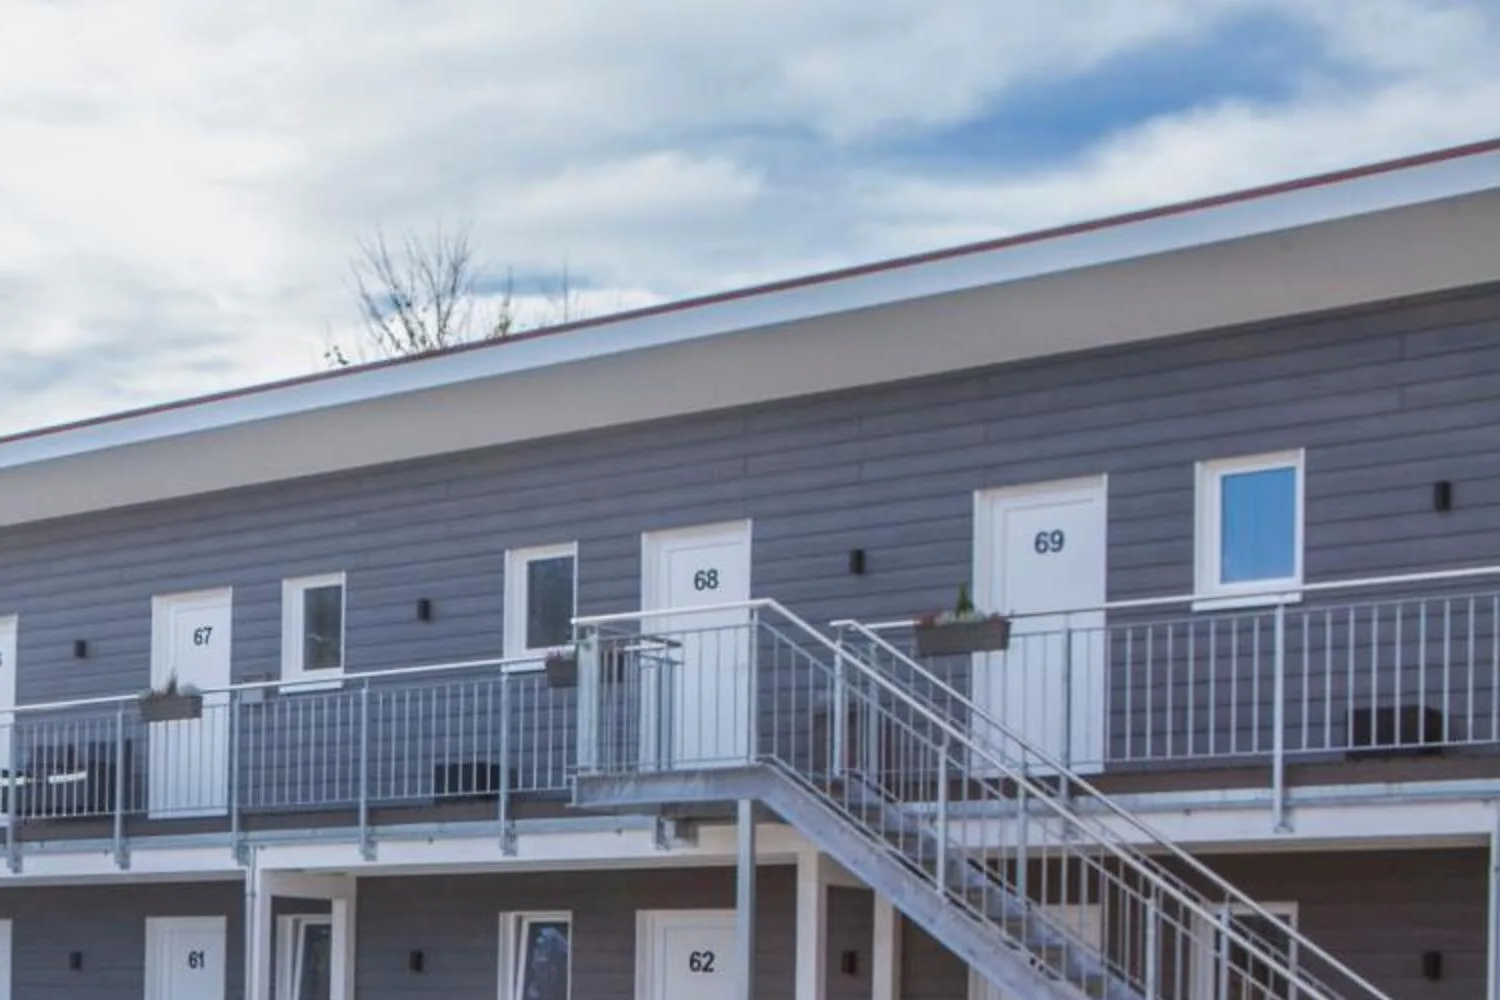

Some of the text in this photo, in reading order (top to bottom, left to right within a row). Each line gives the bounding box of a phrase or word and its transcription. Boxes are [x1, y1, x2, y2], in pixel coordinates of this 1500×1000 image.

[1034, 529, 1064, 555] 69
[694, 568, 719, 591] 68
[194, 626, 212, 646] 67
[188, 950, 205, 969] 61
[689, 950, 715, 973] 62
